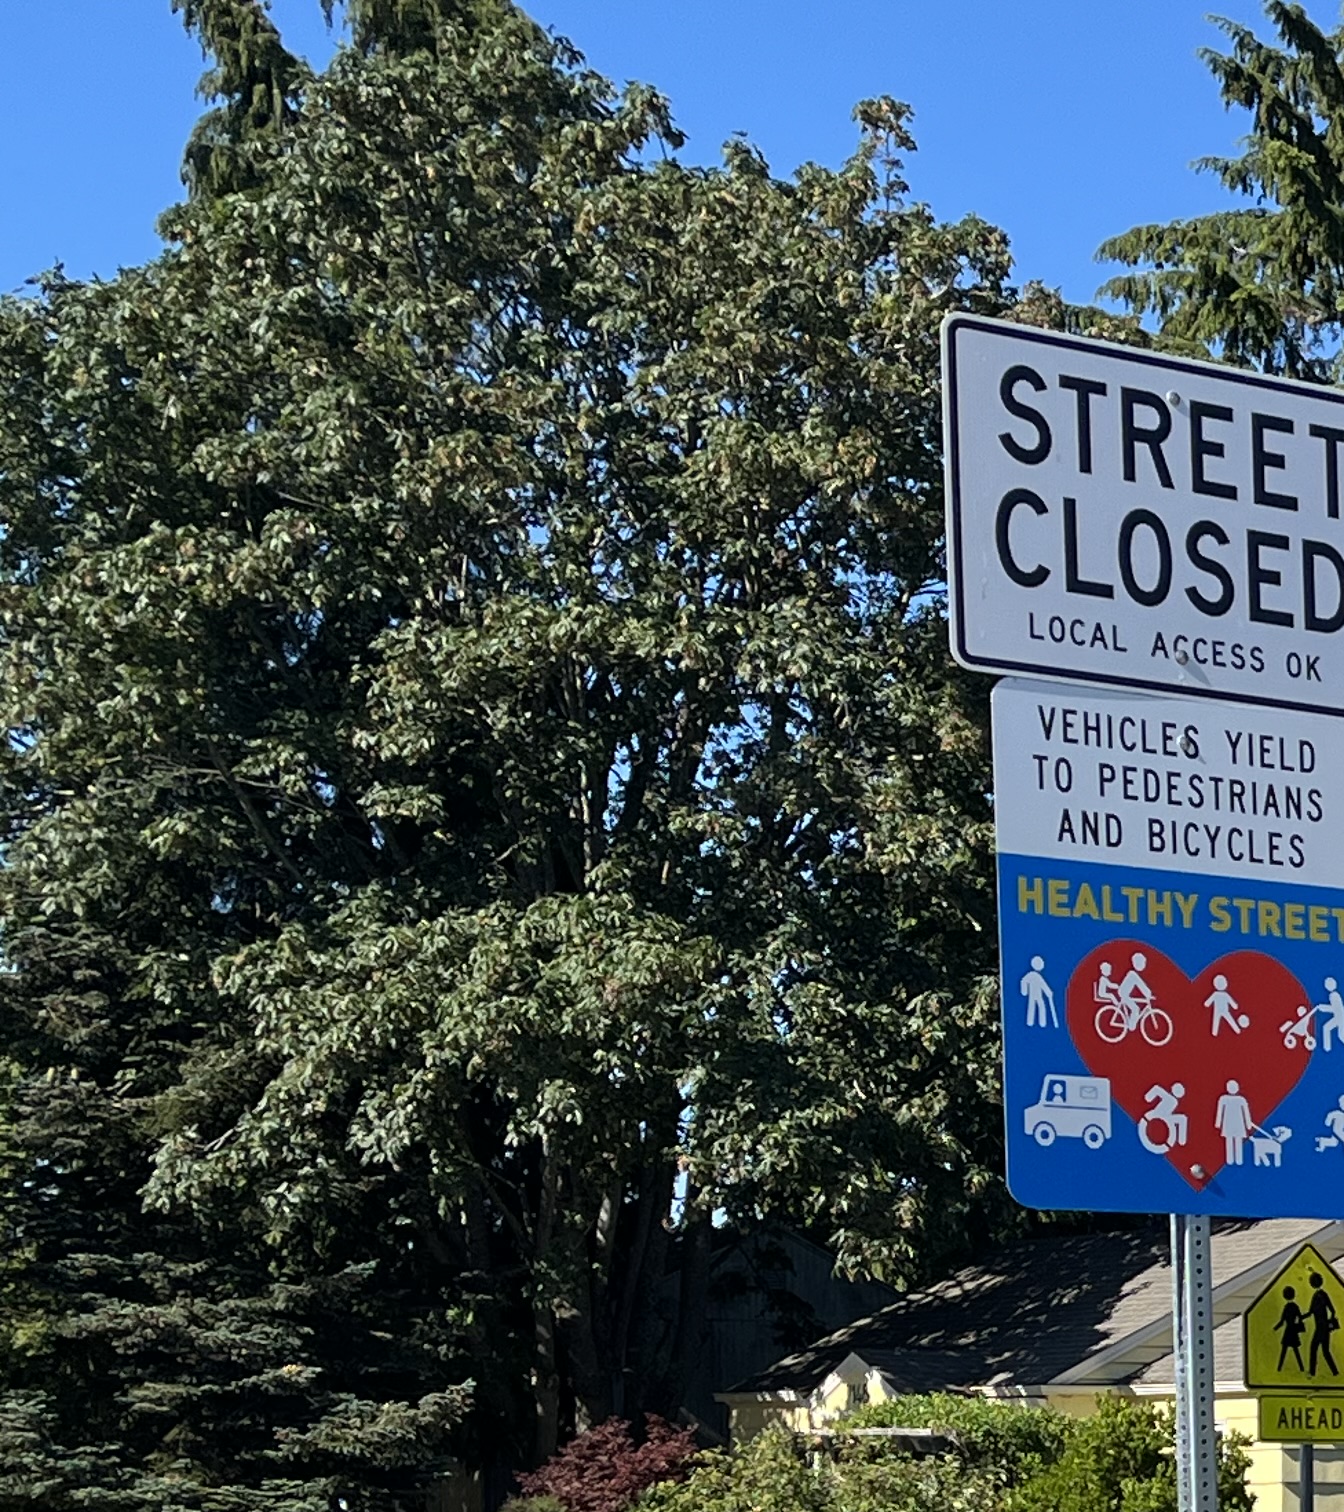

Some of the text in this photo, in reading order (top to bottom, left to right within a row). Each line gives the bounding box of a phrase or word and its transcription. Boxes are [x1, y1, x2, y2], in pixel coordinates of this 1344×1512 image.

[1029, 612, 1322, 682] LOCAL ACCESS OK
[1038, 705, 1316, 774] VEHICLES YIELD
[1033, 754, 1323, 822] TO PEDESTRIANS
[1058, 808, 1305, 868] AND BICYCLES
[1017, 876, 1199, 929] HEALTHY
[1277, 1407, 1343, 1430] AHEAD
